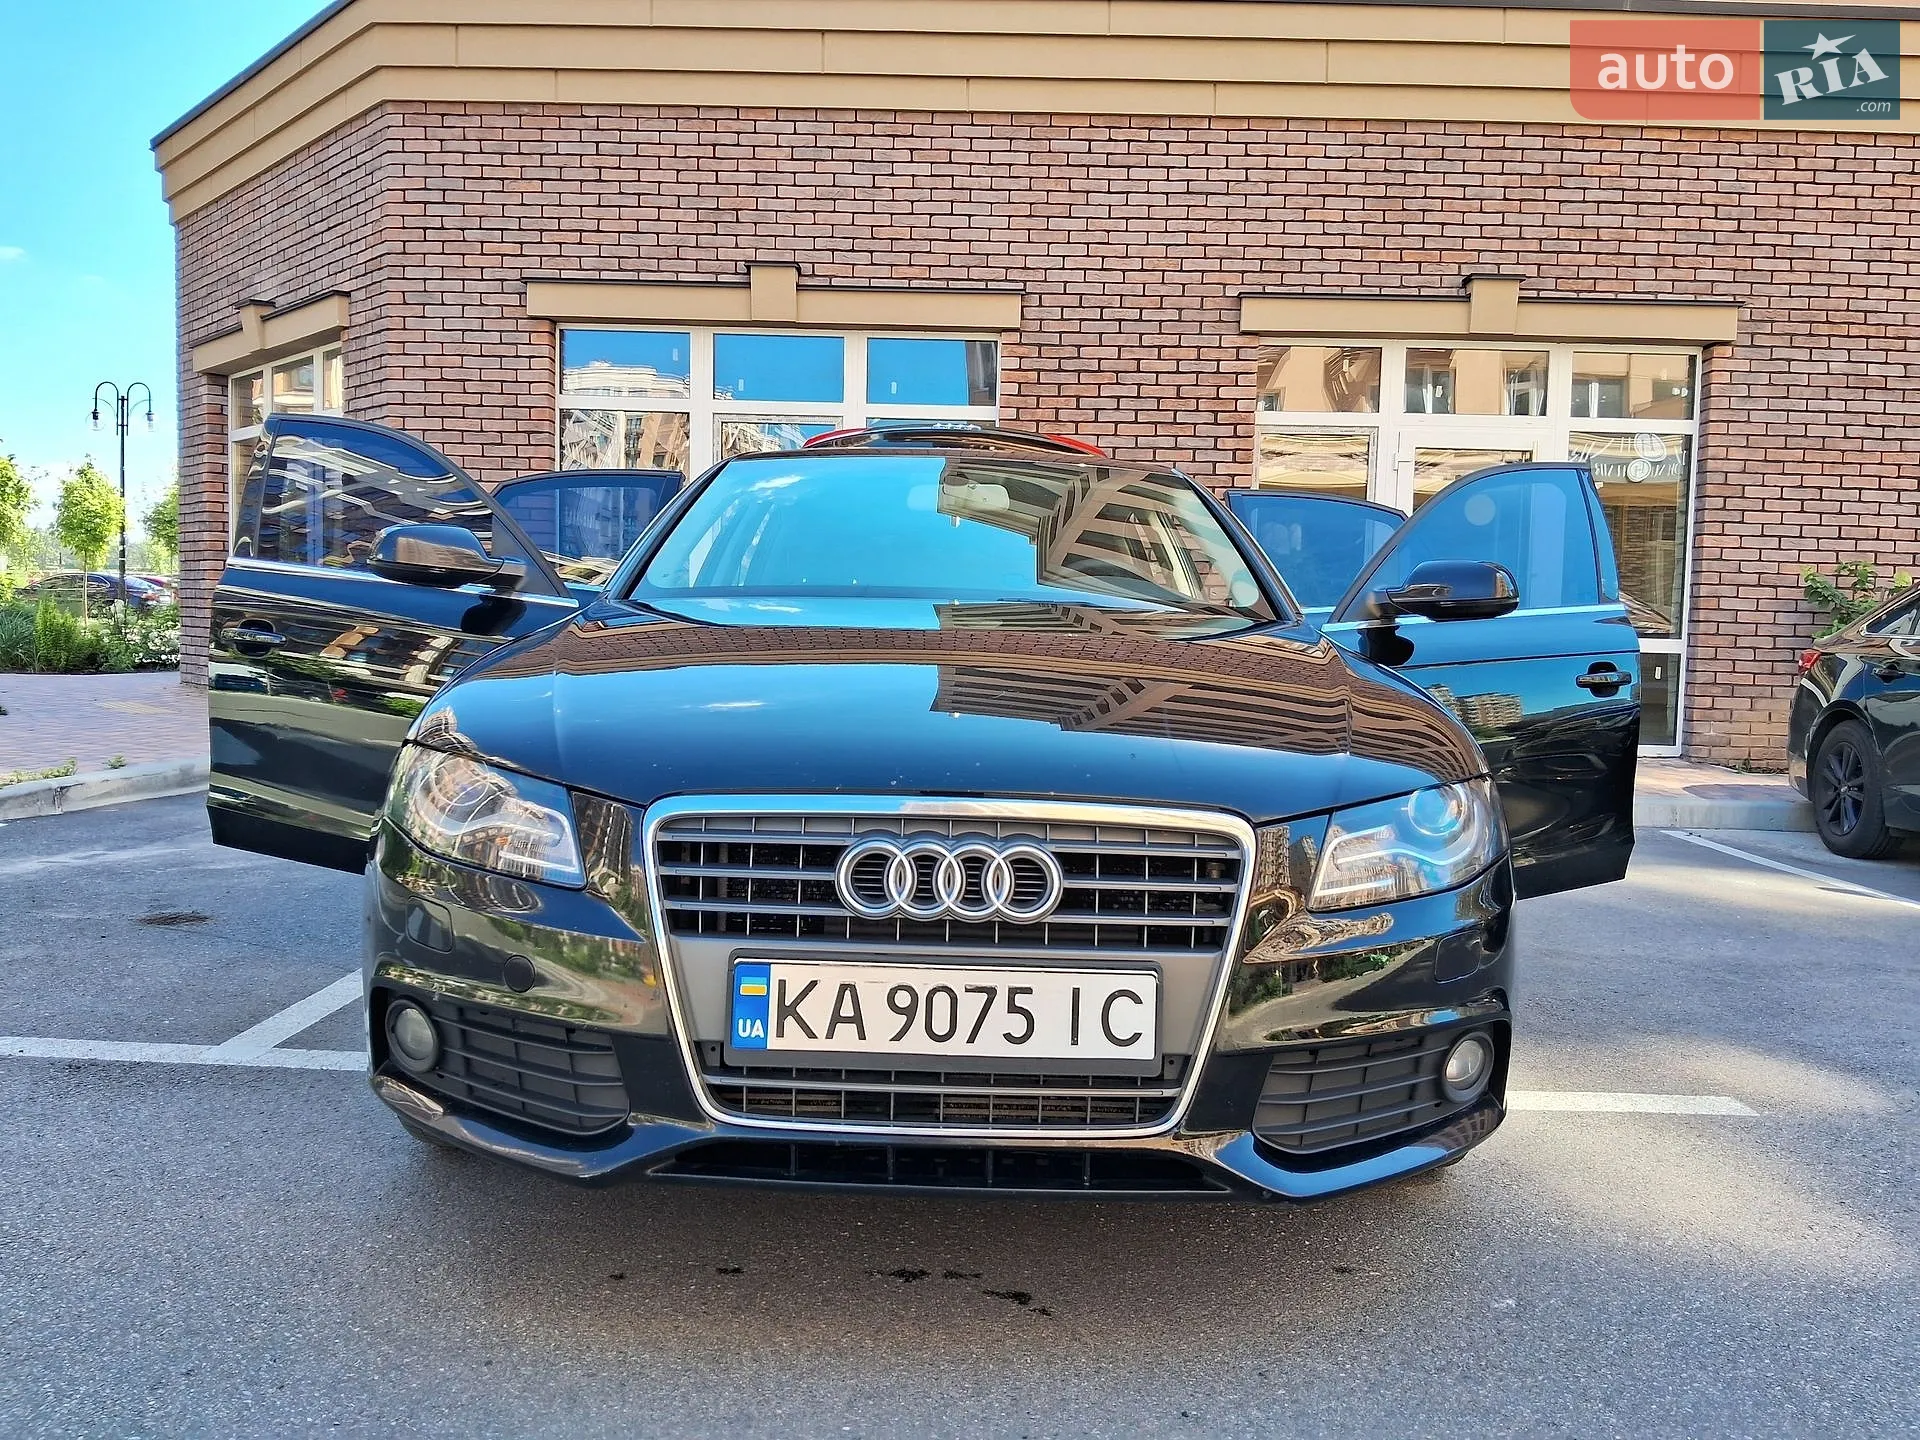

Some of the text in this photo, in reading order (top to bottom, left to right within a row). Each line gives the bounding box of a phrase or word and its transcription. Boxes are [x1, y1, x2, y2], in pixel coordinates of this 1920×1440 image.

[737, 1018, 764, 1039] UA
[775, 978, 867, 1041] KA
[886, 982, 1036, 1046] 9075
